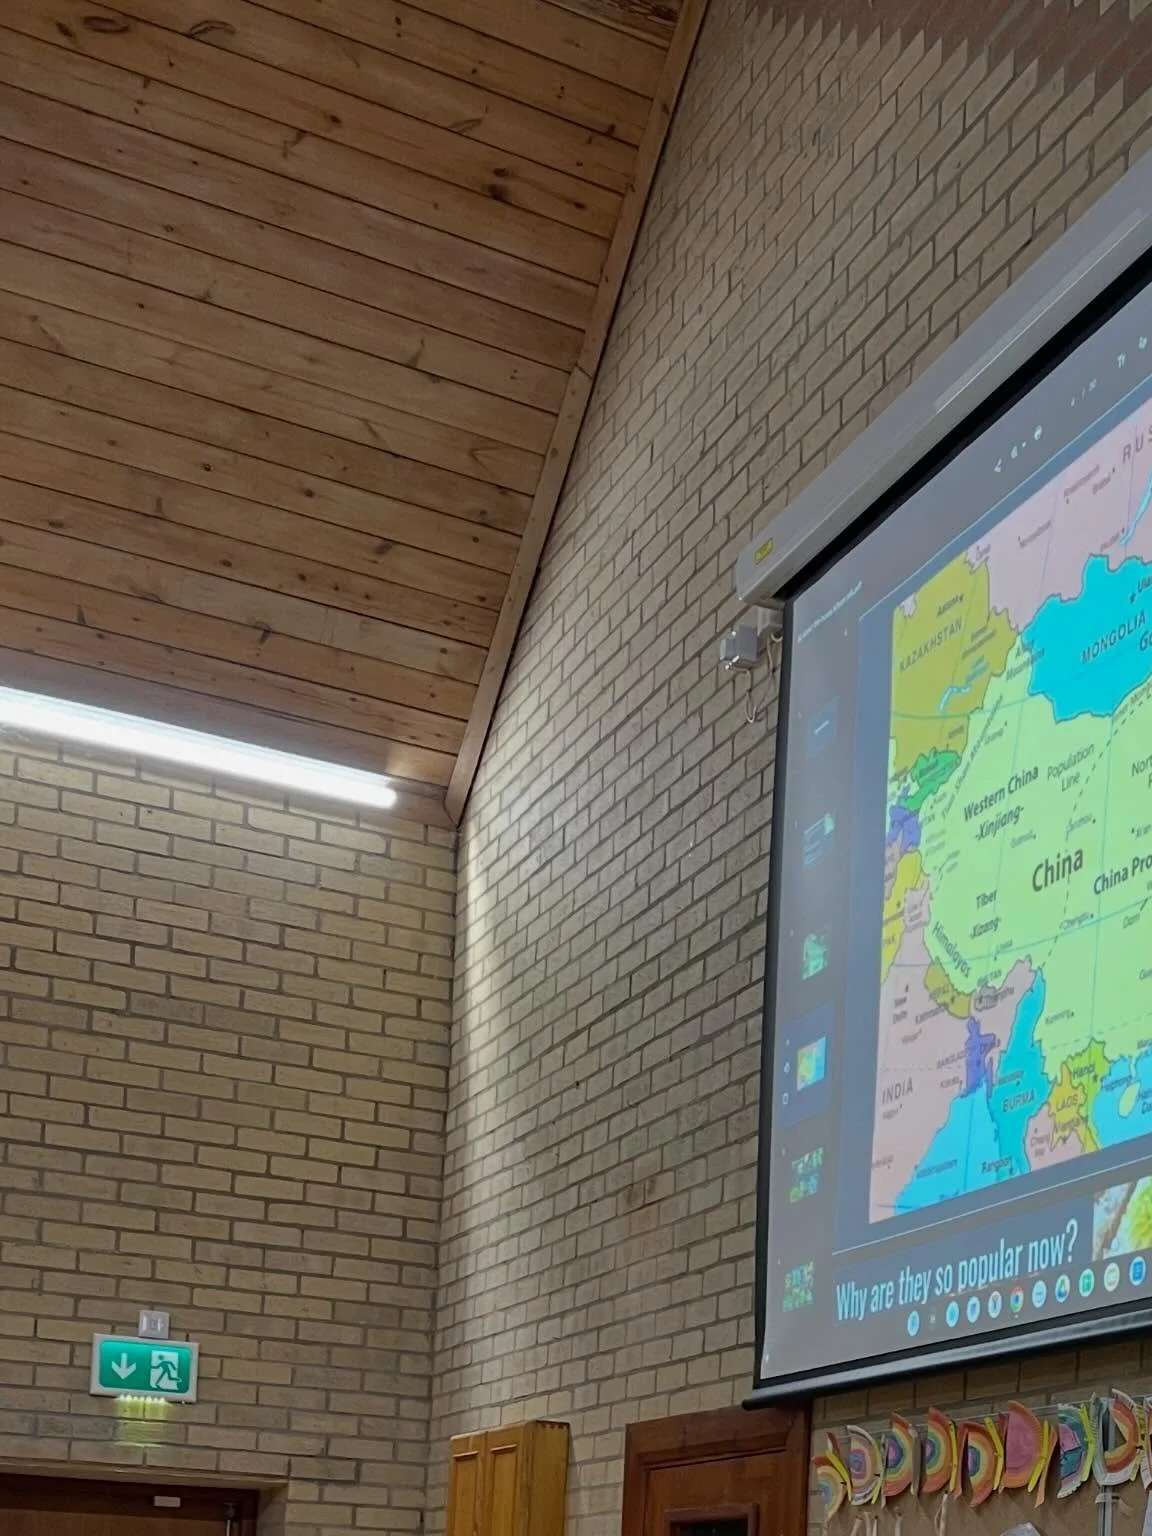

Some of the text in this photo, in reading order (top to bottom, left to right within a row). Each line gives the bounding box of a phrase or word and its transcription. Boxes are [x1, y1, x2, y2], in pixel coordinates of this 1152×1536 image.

[900, 616, 963, 673] KAZAKHSTAN
[1080, 610, 1146, 665] MONGOLIA
[1047, 743, 1095, 781] Population
[963, 766, 1039, 822] Western China
[1061, 772, 1081, 792] Line
[1032, 848, 1084, 892] China
[1093, 867, 1129, 895] China
[976, 889, 998, 909] Tibet
[882, 1077, 913, 1105] INDIA
[1003, 1090, 1035, 1112] BURMA
[1054, 1094, 1079, 1112] LAOS
[836, 1218, 1079, 1322] Why are they so popular now?
